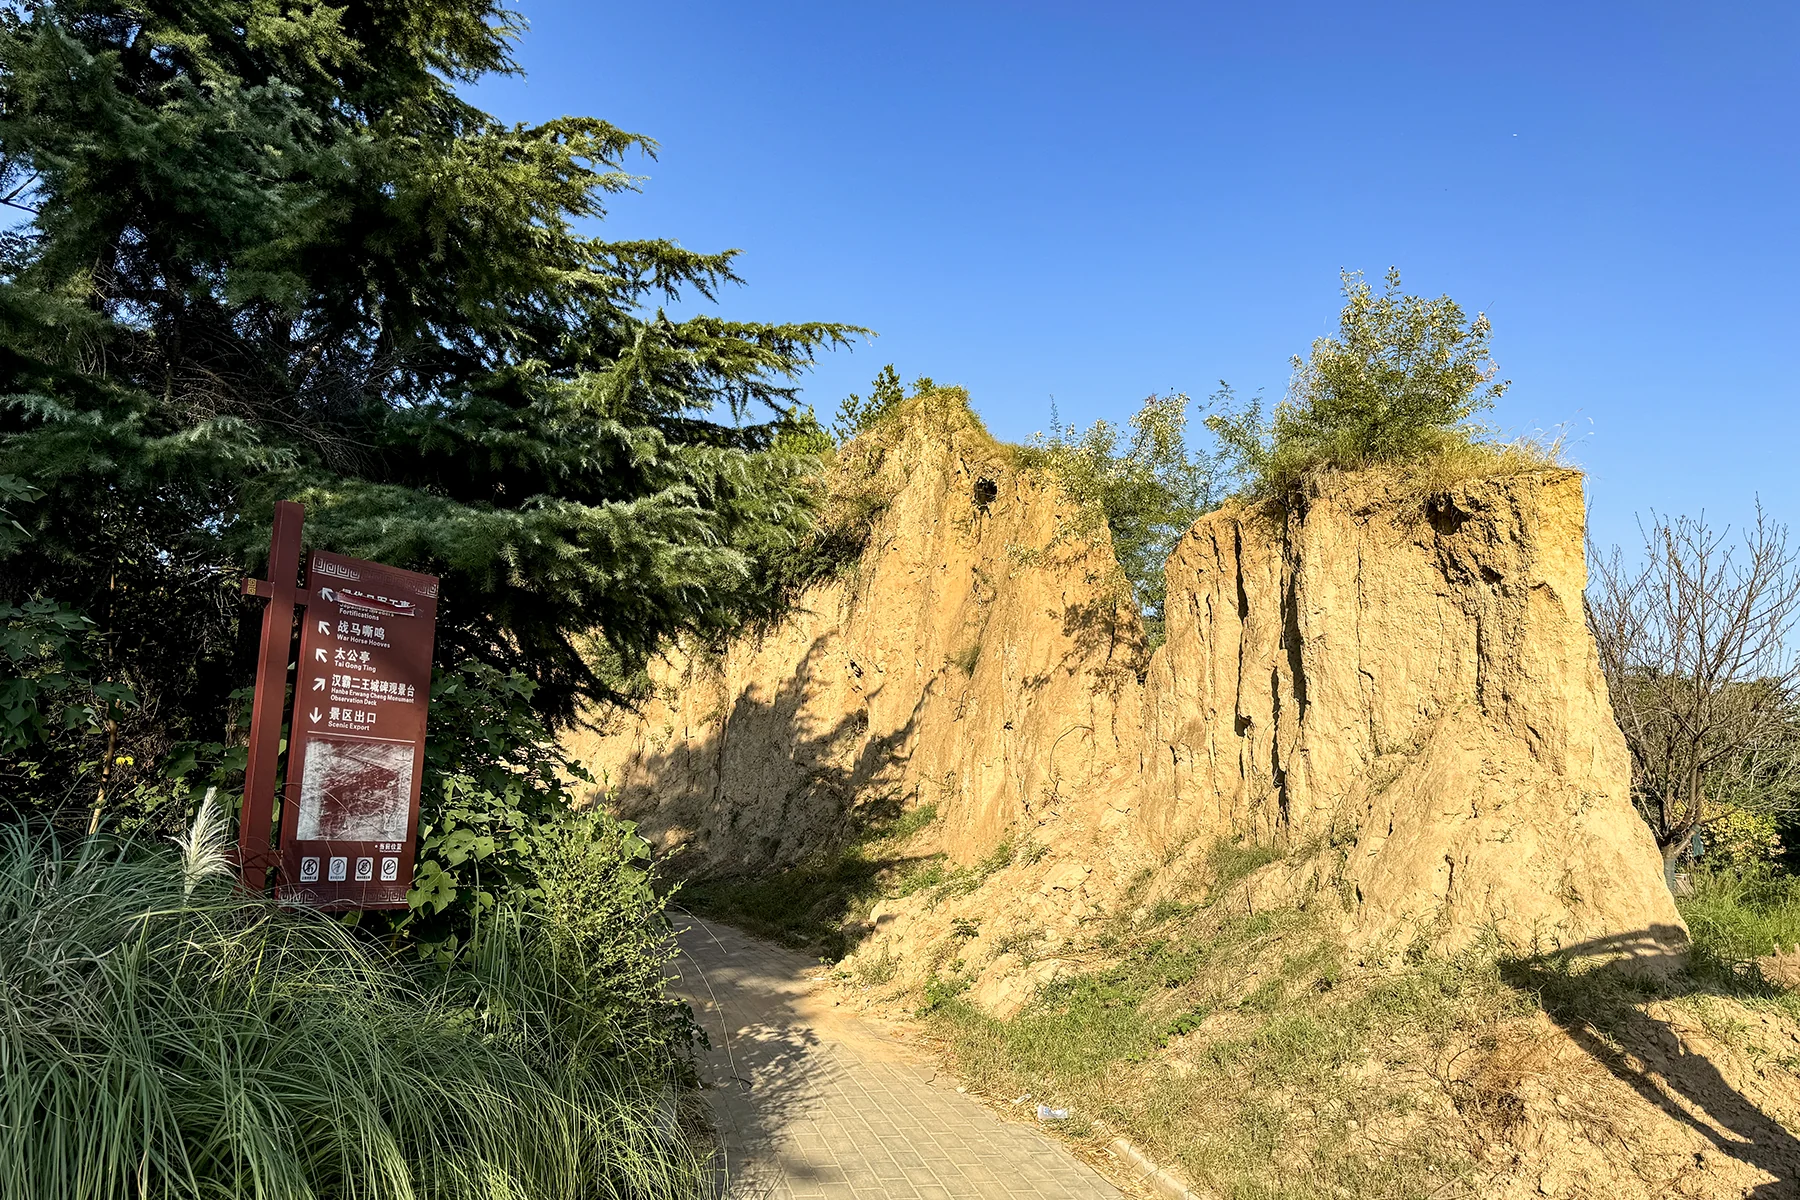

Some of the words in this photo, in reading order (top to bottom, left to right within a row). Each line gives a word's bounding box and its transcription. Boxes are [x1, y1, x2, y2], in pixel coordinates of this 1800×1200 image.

[339, 608, 379, 620] Fortifications
[338, 621, 385, 640] 战马嘶鸣
[369, 640, 390, 648] Hooves
[335, 647, 370, 663] 太公亭
[346, 662, 361, 670] Gong
[332, 674, 415, 697] 汉霸二王城碑观景台
[330, 694, 363, 704] Observation
[331, 687, 348, 695] Hanba
[349, 690, 369, 698] Erwang
[370, 693, 386, 701] Cheng
[388, 695, 414, 703] Monument
[329, 707, 376, 723] 景区出口
[328, 721, 349, 729] Scenic
[350, 723, 370, 731] Export
